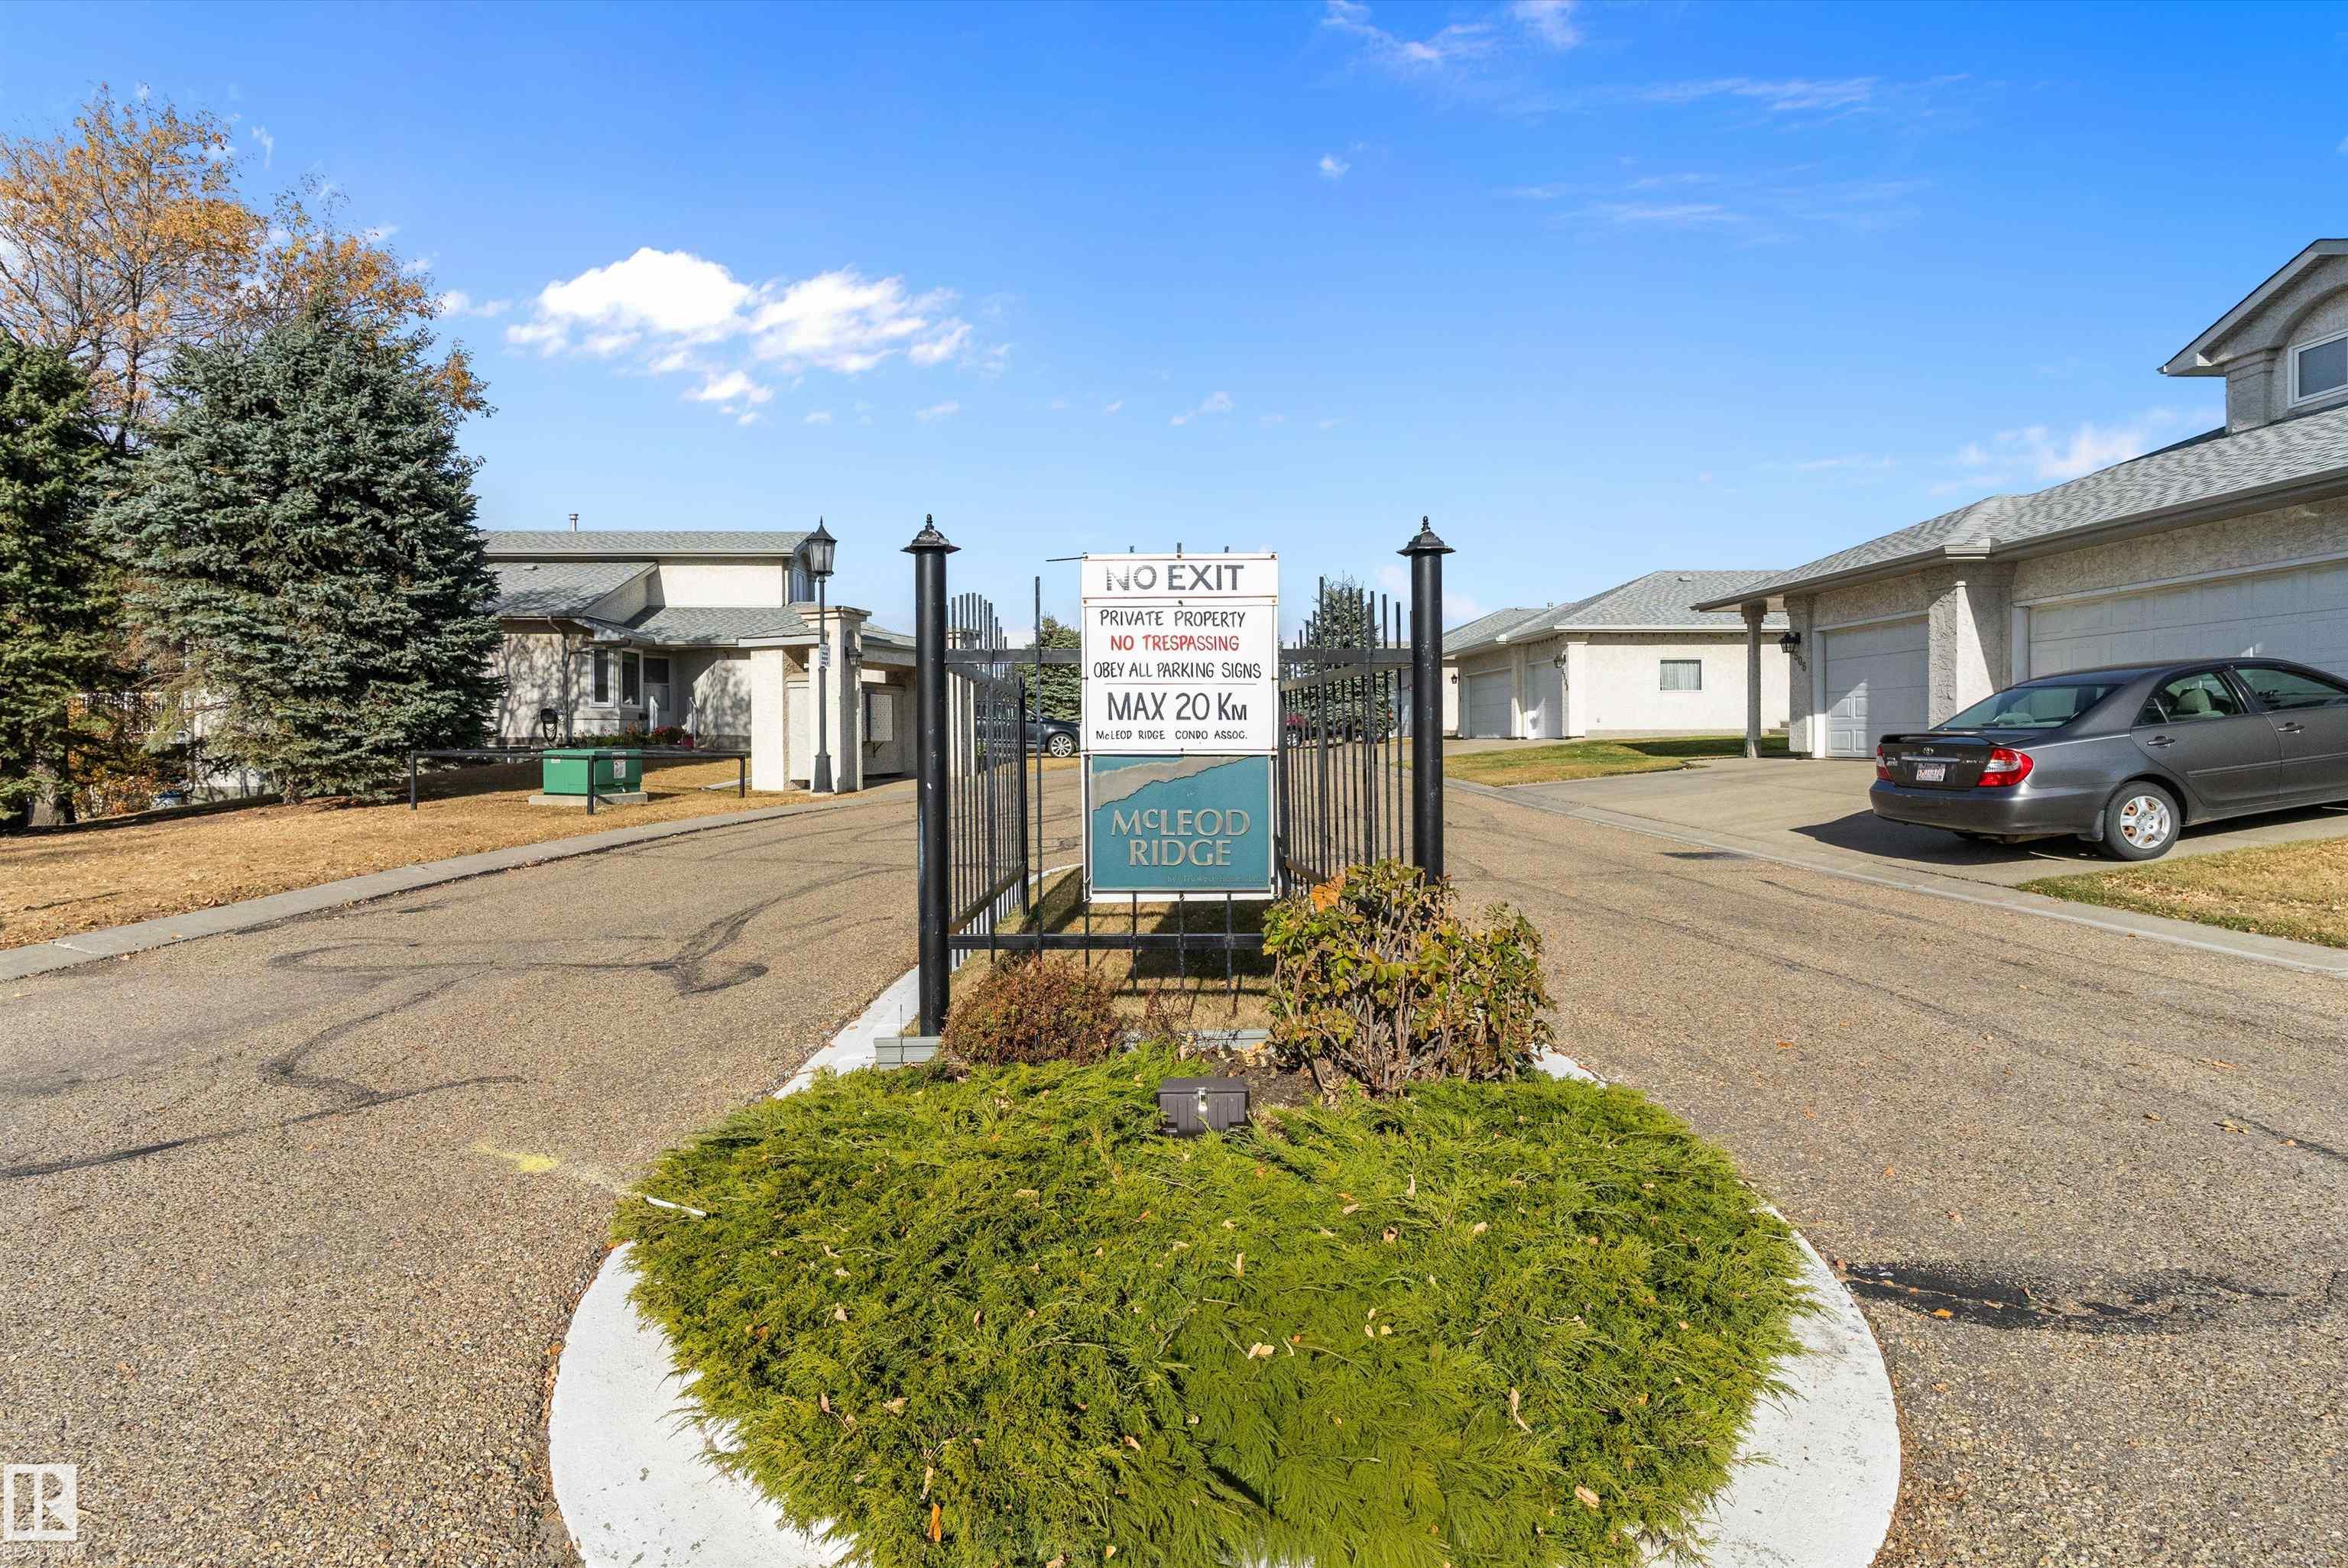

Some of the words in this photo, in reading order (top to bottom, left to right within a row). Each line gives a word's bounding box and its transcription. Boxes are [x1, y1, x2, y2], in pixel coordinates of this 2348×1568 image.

[1106, 565, 1157, 591] NO
[1168, 565, 1244, 591] EXIT
[1099, 609, 1164, 627] PRIVATE
[1174, 611, 1246, 627] PROPERTY
[1111, 635, 1134, 651] NO
[1142, 634, 1240, 651] TRESPASSING
[1094, 662, 1125, 679] OBEY
[1129, 663, 1153, 678] ALL
[1156, 662, 1215, 679] PARKING
[1221, 663, 1261, 679] SIGNS
[1108, 692, 1167, 721] MAX
[1175, 692, 1210, 721] 20
[1138, 730, 1166, 740] RIDGE
[1175, 731, 1208, 740] CONDO
[1214, 731, 1248, 740] ASSOC.
[1128, 839, 1232, 867] RIDGE
